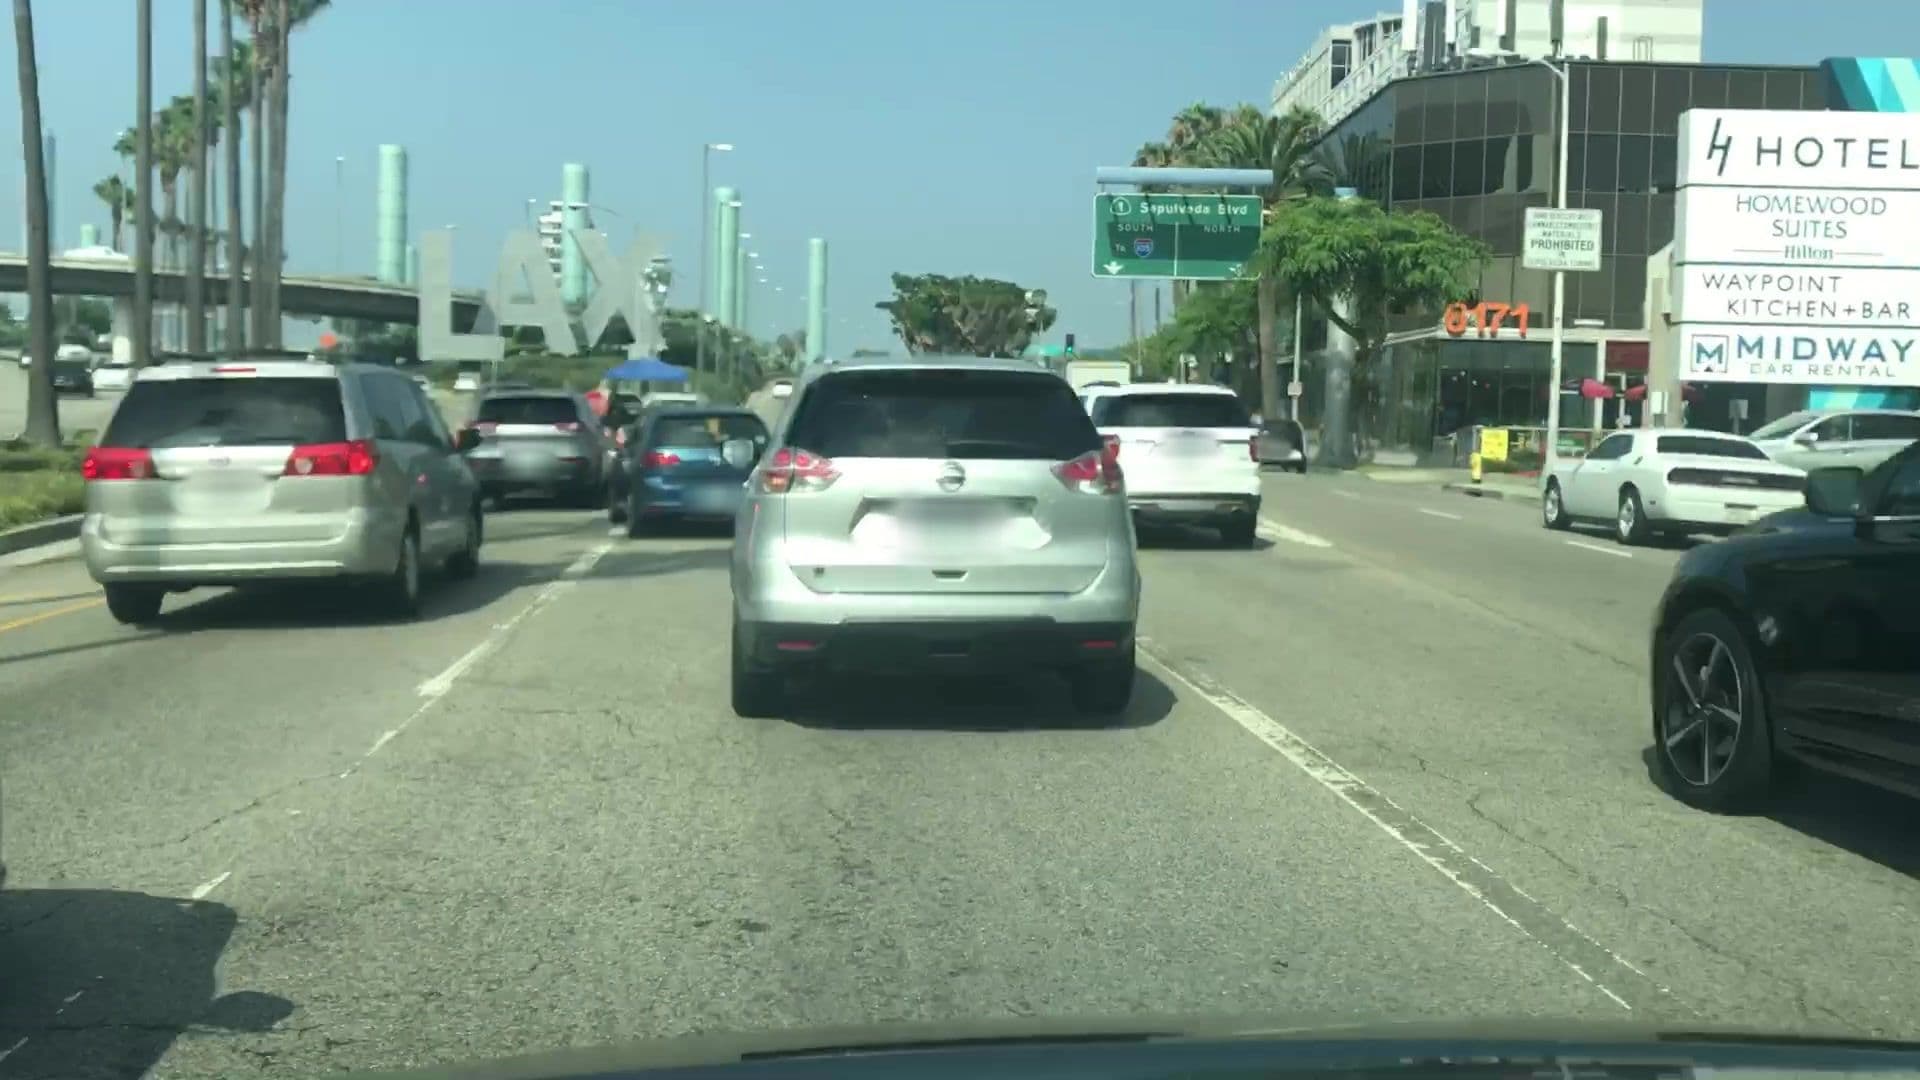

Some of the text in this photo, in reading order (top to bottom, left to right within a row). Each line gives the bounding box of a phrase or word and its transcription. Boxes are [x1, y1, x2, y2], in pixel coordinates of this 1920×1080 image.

[1755, 136, 1920, 169] HOTEL
[1140, 201, 1210, 216] Sepulveda
[1217, 203, 1248, 215] Blvd
[1736, 194, 1887, 216] HOMEWOOD
[1117, 223, 1154, 232] SOUTH
[1203, 224, 1241, 233] NORTH
[1772, 219, 1848, 239] SUITES
[1530, 239, 1594, 251] PROHIBITED
[1784, 244, 1834, 260] Hilton
[1702, 272, 1843, 293] WAYPOINT
[1444, 299, 1530, 339] 0171
[1737, 334, 1915, 364] MIDWAY
[1749, 363, 1897, 378] CAR RENTAL
